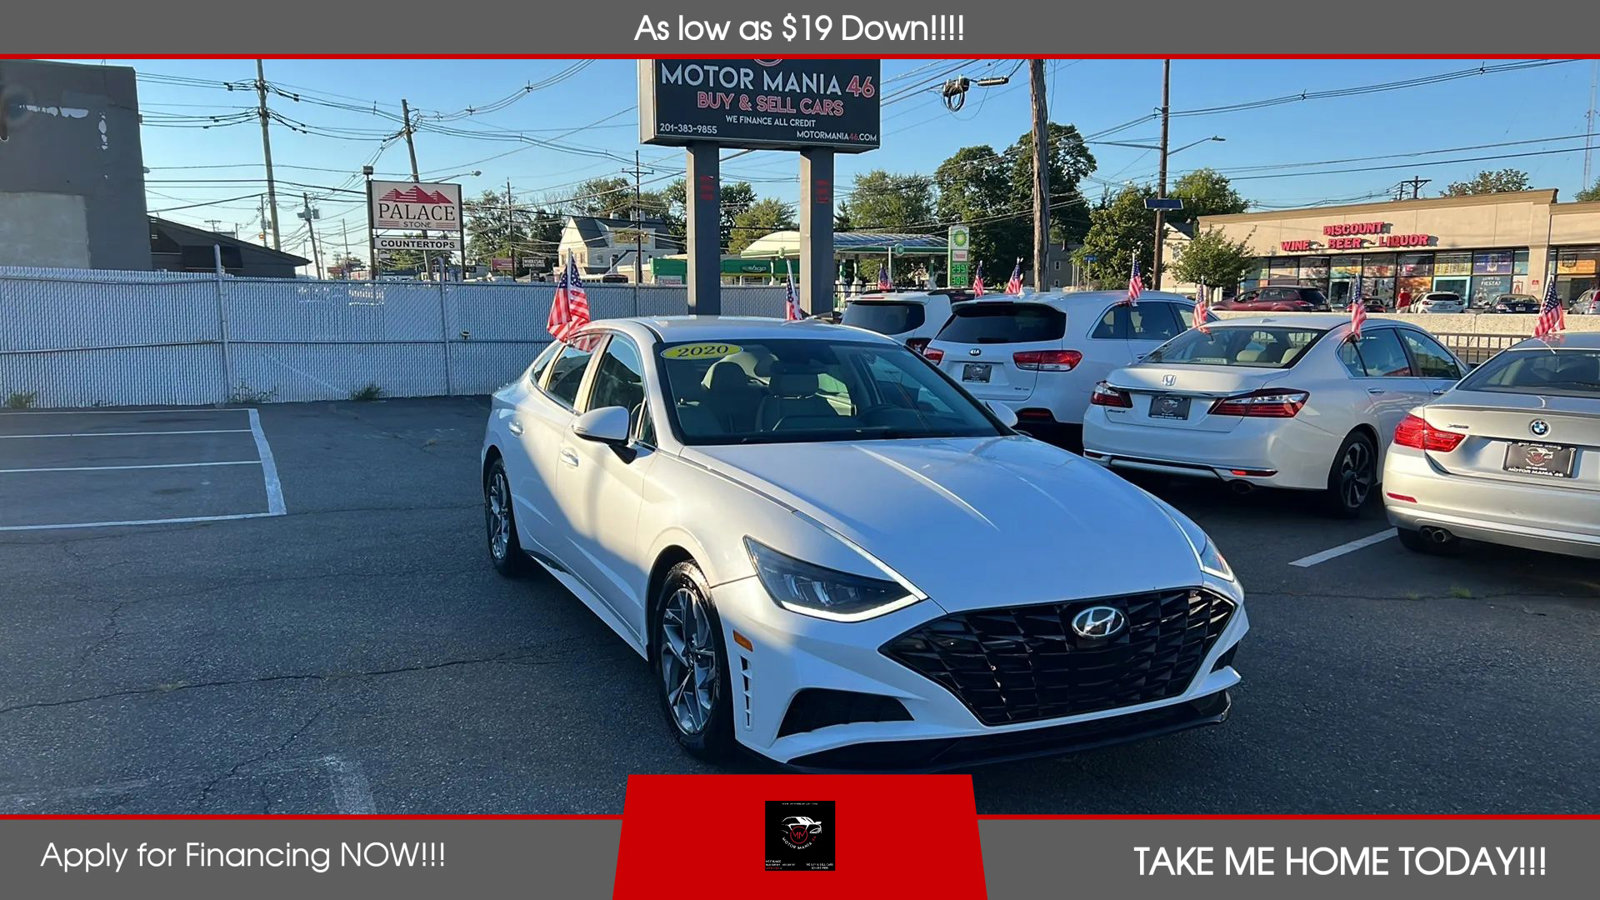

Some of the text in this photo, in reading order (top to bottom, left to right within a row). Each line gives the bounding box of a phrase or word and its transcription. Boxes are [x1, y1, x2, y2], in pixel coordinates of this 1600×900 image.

[661, 63, 875, 98] MOTOR MANIA 46
[697, 91, 844, 117] BUY & SELL CARS
[726, 115, 816, 127] WE FINANCE ALL CREDIT
[660, 122, 718, 134] 201-383-9855
[796, 130, 877, 142] MOTORMANIA46.COM
[378, 203, 455, 221] PALACE
[1323, 221, 1385, 235] DISCOUNT
[380, 240, 455, 249] COUNTERTOPS
[1281, 234, 1429, 252] WINE BEER LIQUOR
[678, 345, 729, 357] 2020
